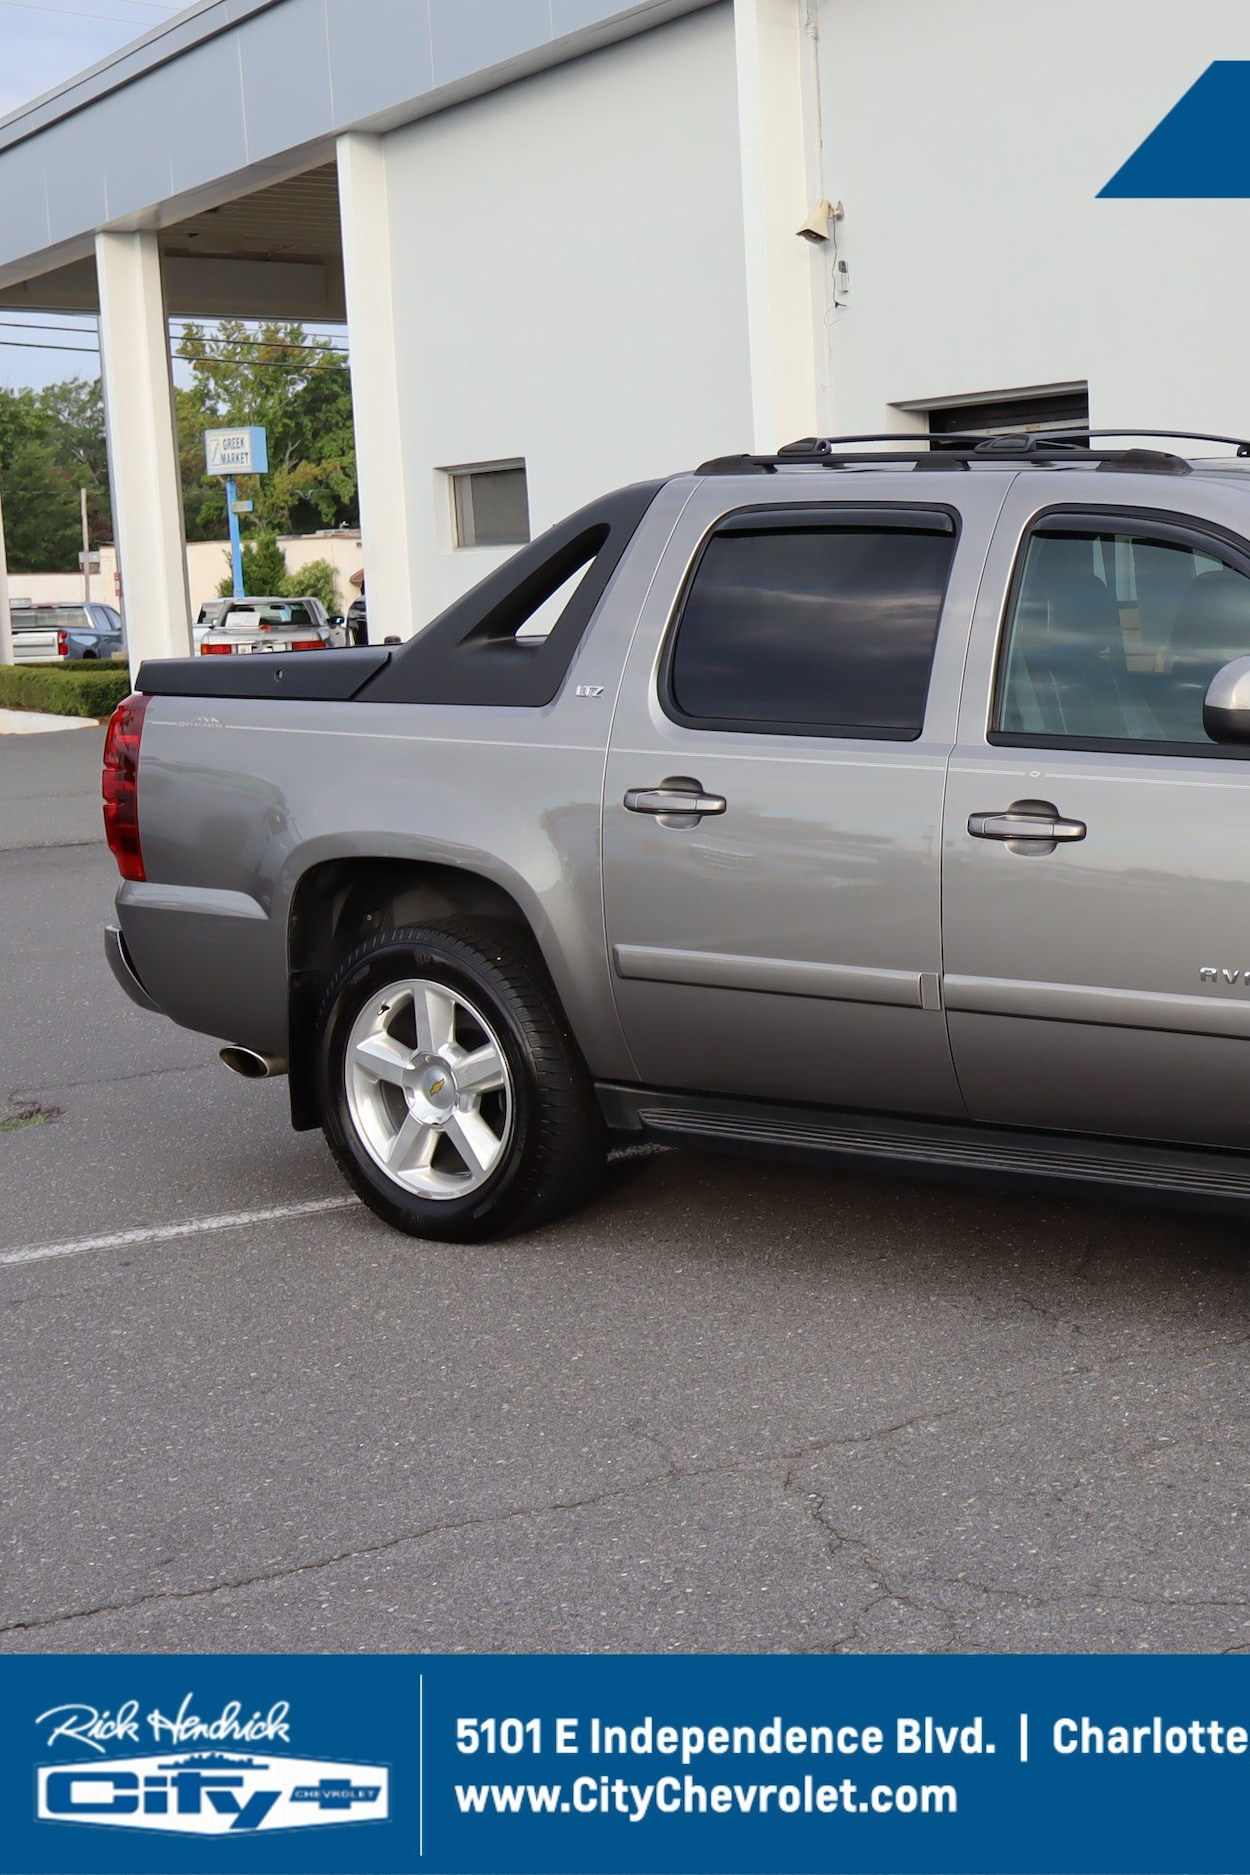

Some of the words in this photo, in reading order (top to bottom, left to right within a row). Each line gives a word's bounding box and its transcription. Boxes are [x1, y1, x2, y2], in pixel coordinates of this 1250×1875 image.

[223, 436, 246, 450] GREEK
[221, 452, 249, 465] MARKET
[576, 685, 604, 698] LTZ
